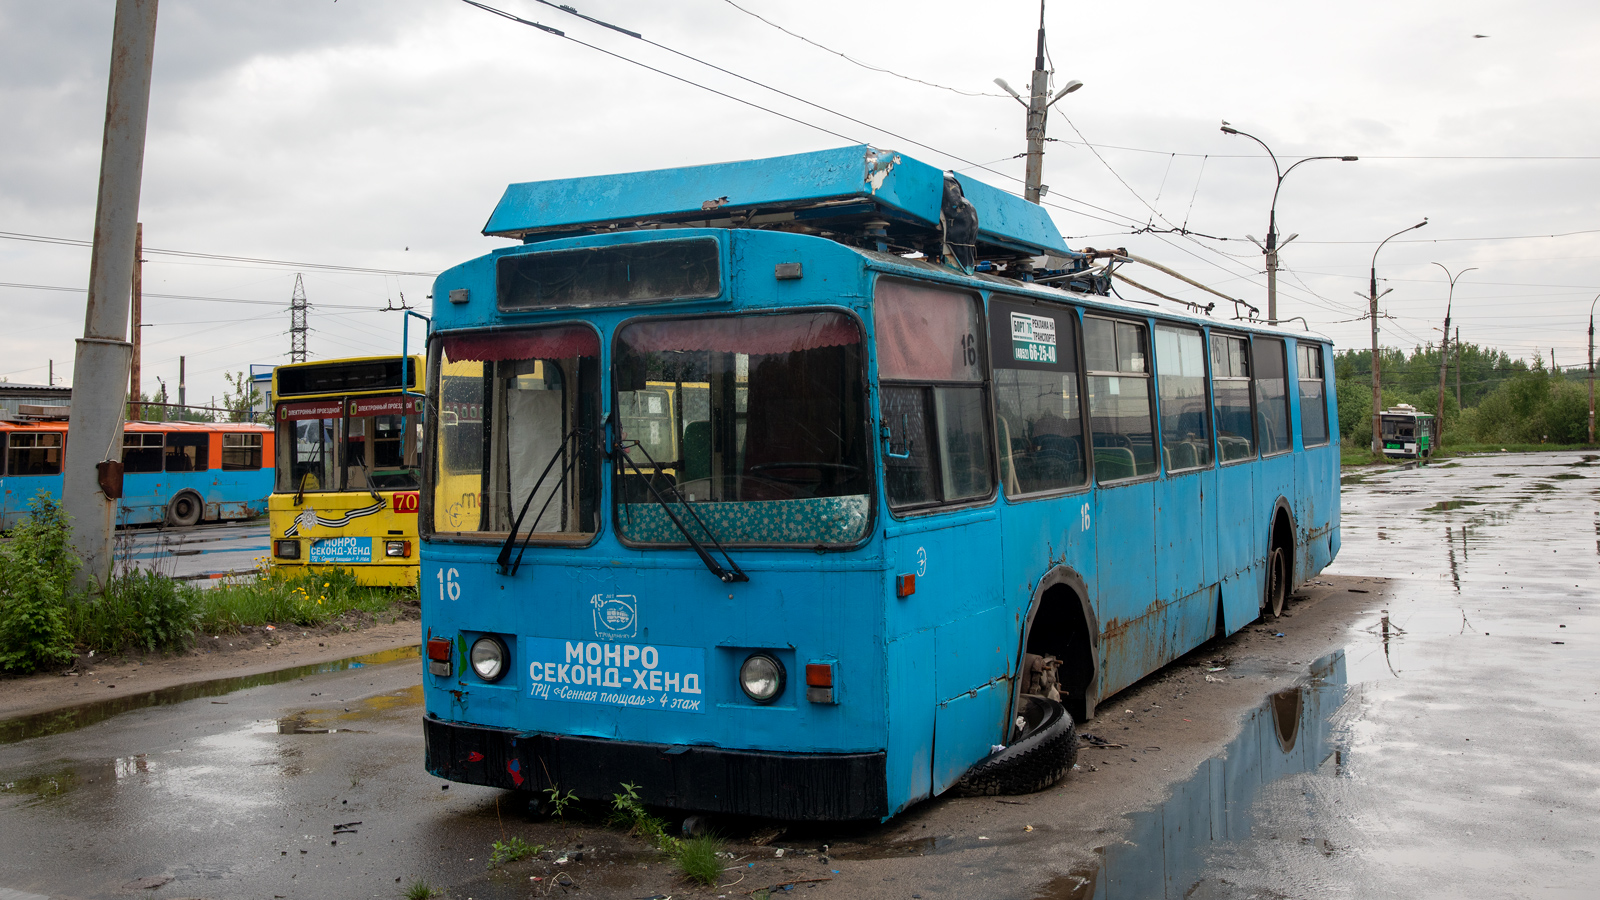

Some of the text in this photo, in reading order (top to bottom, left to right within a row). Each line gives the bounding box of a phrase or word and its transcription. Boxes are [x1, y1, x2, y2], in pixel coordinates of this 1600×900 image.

[961, 334, 976, 366] 16
[1029, 344, 1056, 362] 66-25-40
[288, 406, 340, 416] ЭЛЕКТРОННЫЙ ПРОЕЗДНОЙ
[358, 403, 387, 412] ЭЛЕКТРОННЫЙ
[395, 494, 417, 510] 70
[1081, 502, 1090, 532] 16
[311, 546, 370, 555] СЕКОНД-ХЕНД
[324, 538, 356, 547] МОНРО
[437, 568, 460, 601] 16
[590, 594, 604, 608] 45
[566, 641, 658, 669] МОНРО
[530, 661, 702, 694] СЕКОНД-ХЕНД
[530, 683, 700, 710] ТРЦ «Сенная площадь» 4 этаж
